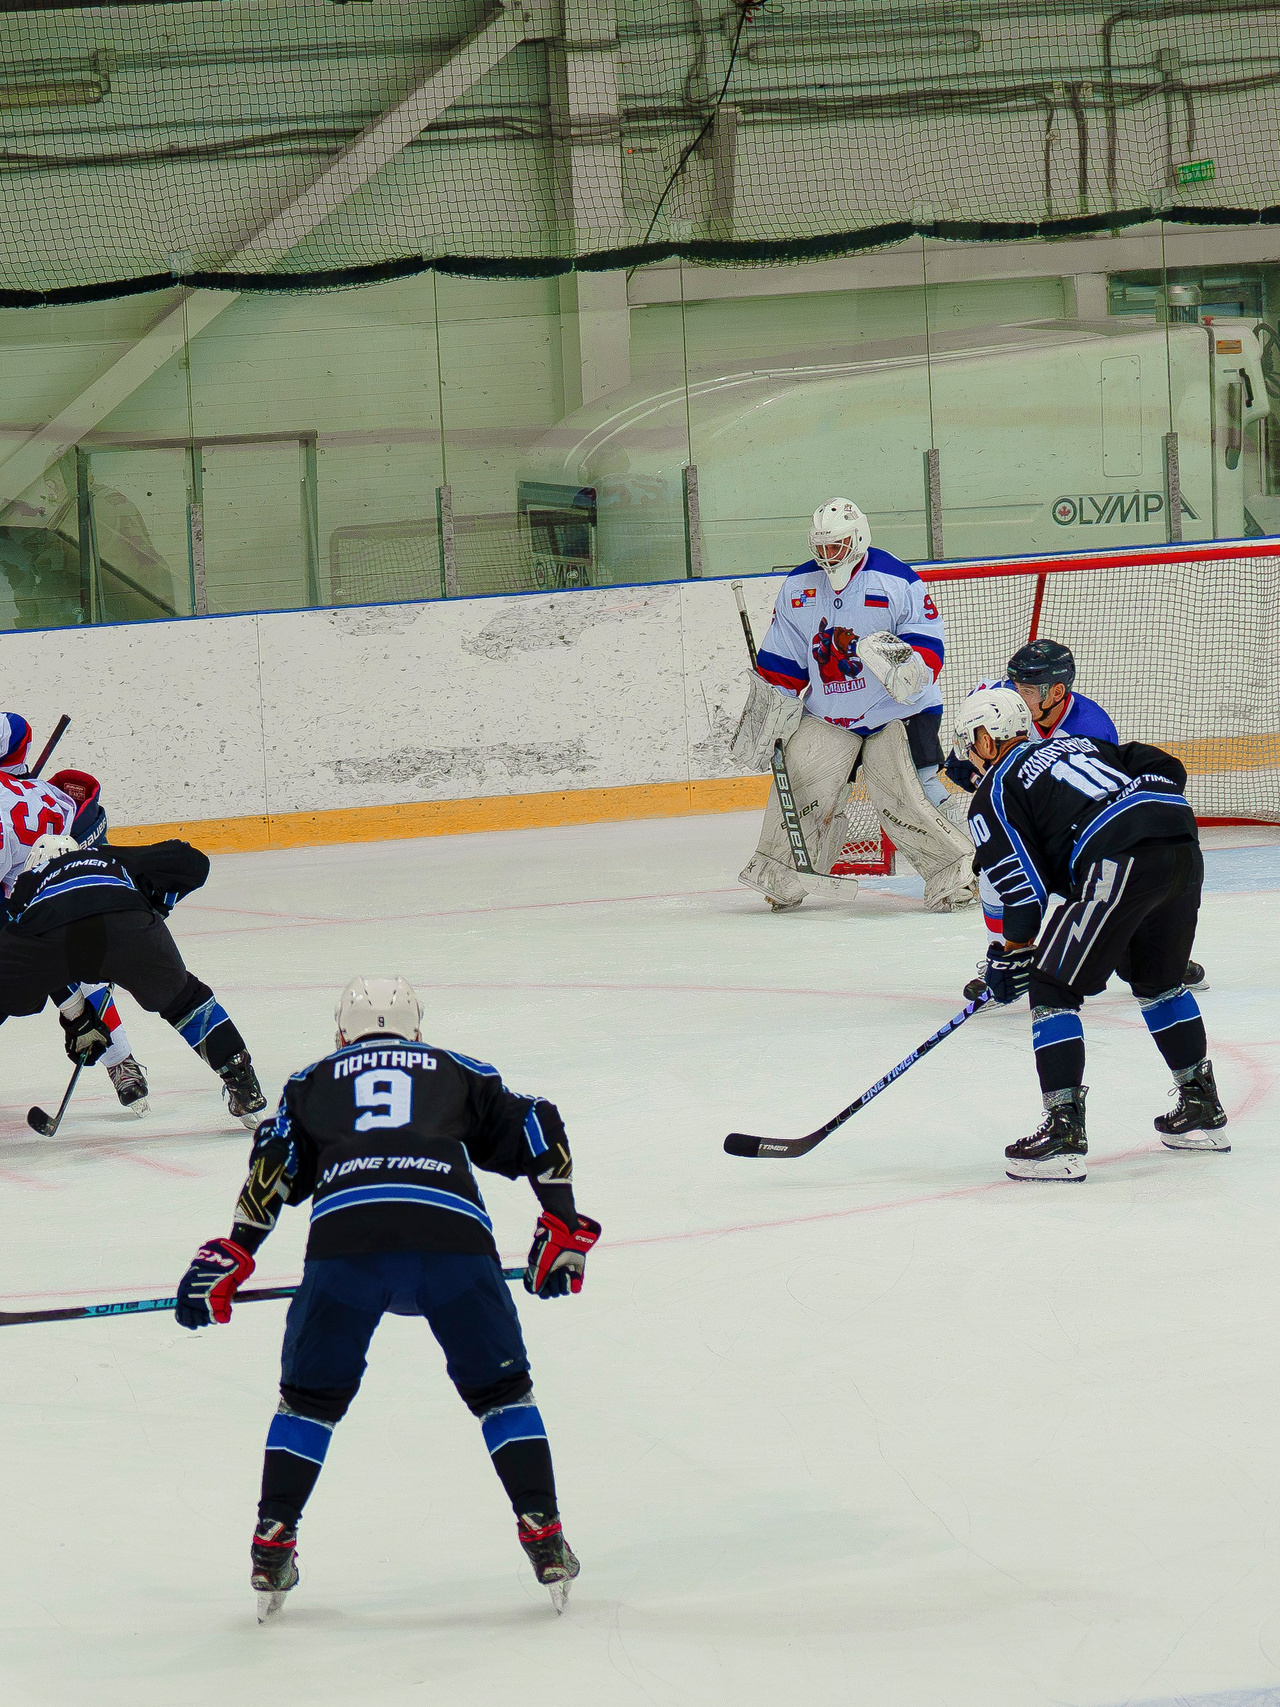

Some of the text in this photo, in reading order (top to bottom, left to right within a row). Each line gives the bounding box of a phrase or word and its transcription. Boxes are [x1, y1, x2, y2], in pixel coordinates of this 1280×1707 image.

[1052, 493, 1198, 526] OLYMPA
[377, 1016, 385, 1028] 9
[334, 1050, 437, 1080] ПОЧТАРЬ
[884, 1049, 919, 1082] TIMER
[354, 1069, 413, 1131] 9
[338, 1156, 452, 1176] ONE TIMER
